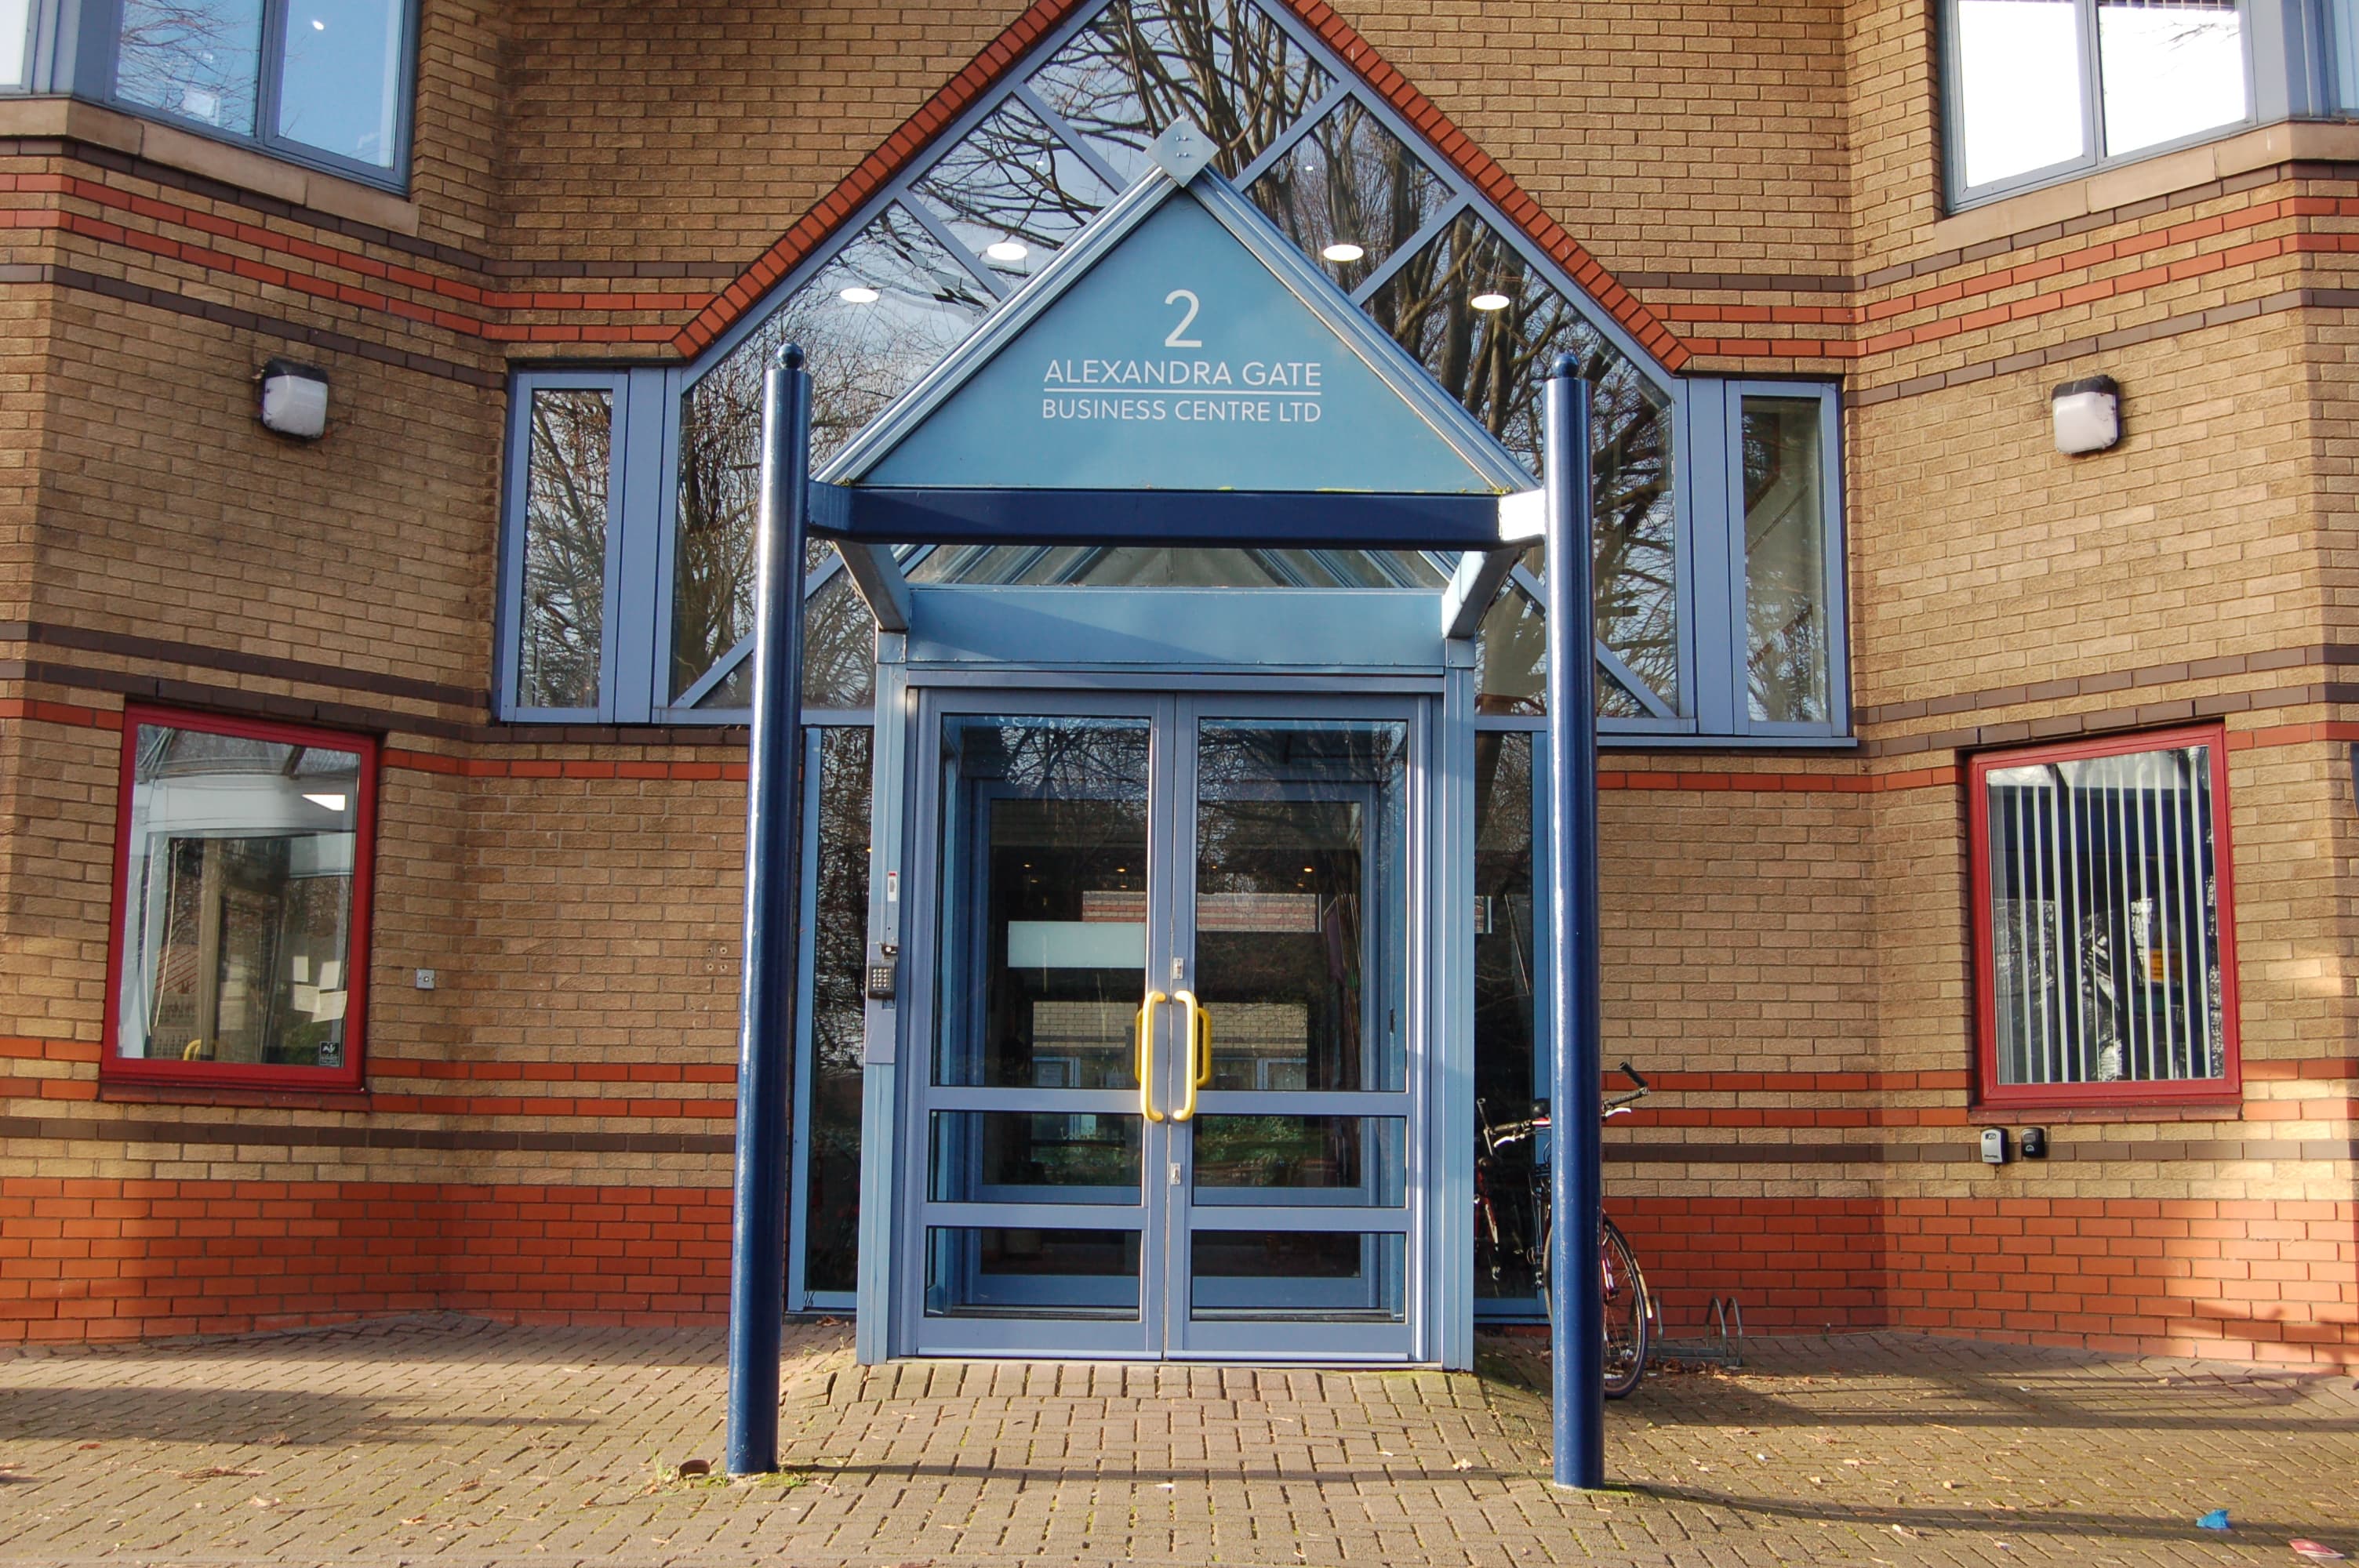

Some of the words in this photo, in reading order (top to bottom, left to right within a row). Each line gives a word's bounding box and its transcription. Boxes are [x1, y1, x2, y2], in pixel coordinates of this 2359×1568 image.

[1165, 289, 1202, 347] 2
[1044, 359, 1233, 385] ALEXANDRA
[1242, 361, 1321, 387] GATE
[1042, 399, 1166, 420] BUSINESS
[1175, 401, 1270, 422] CENTRE
[1279, 402, 1321, 423] LTD
